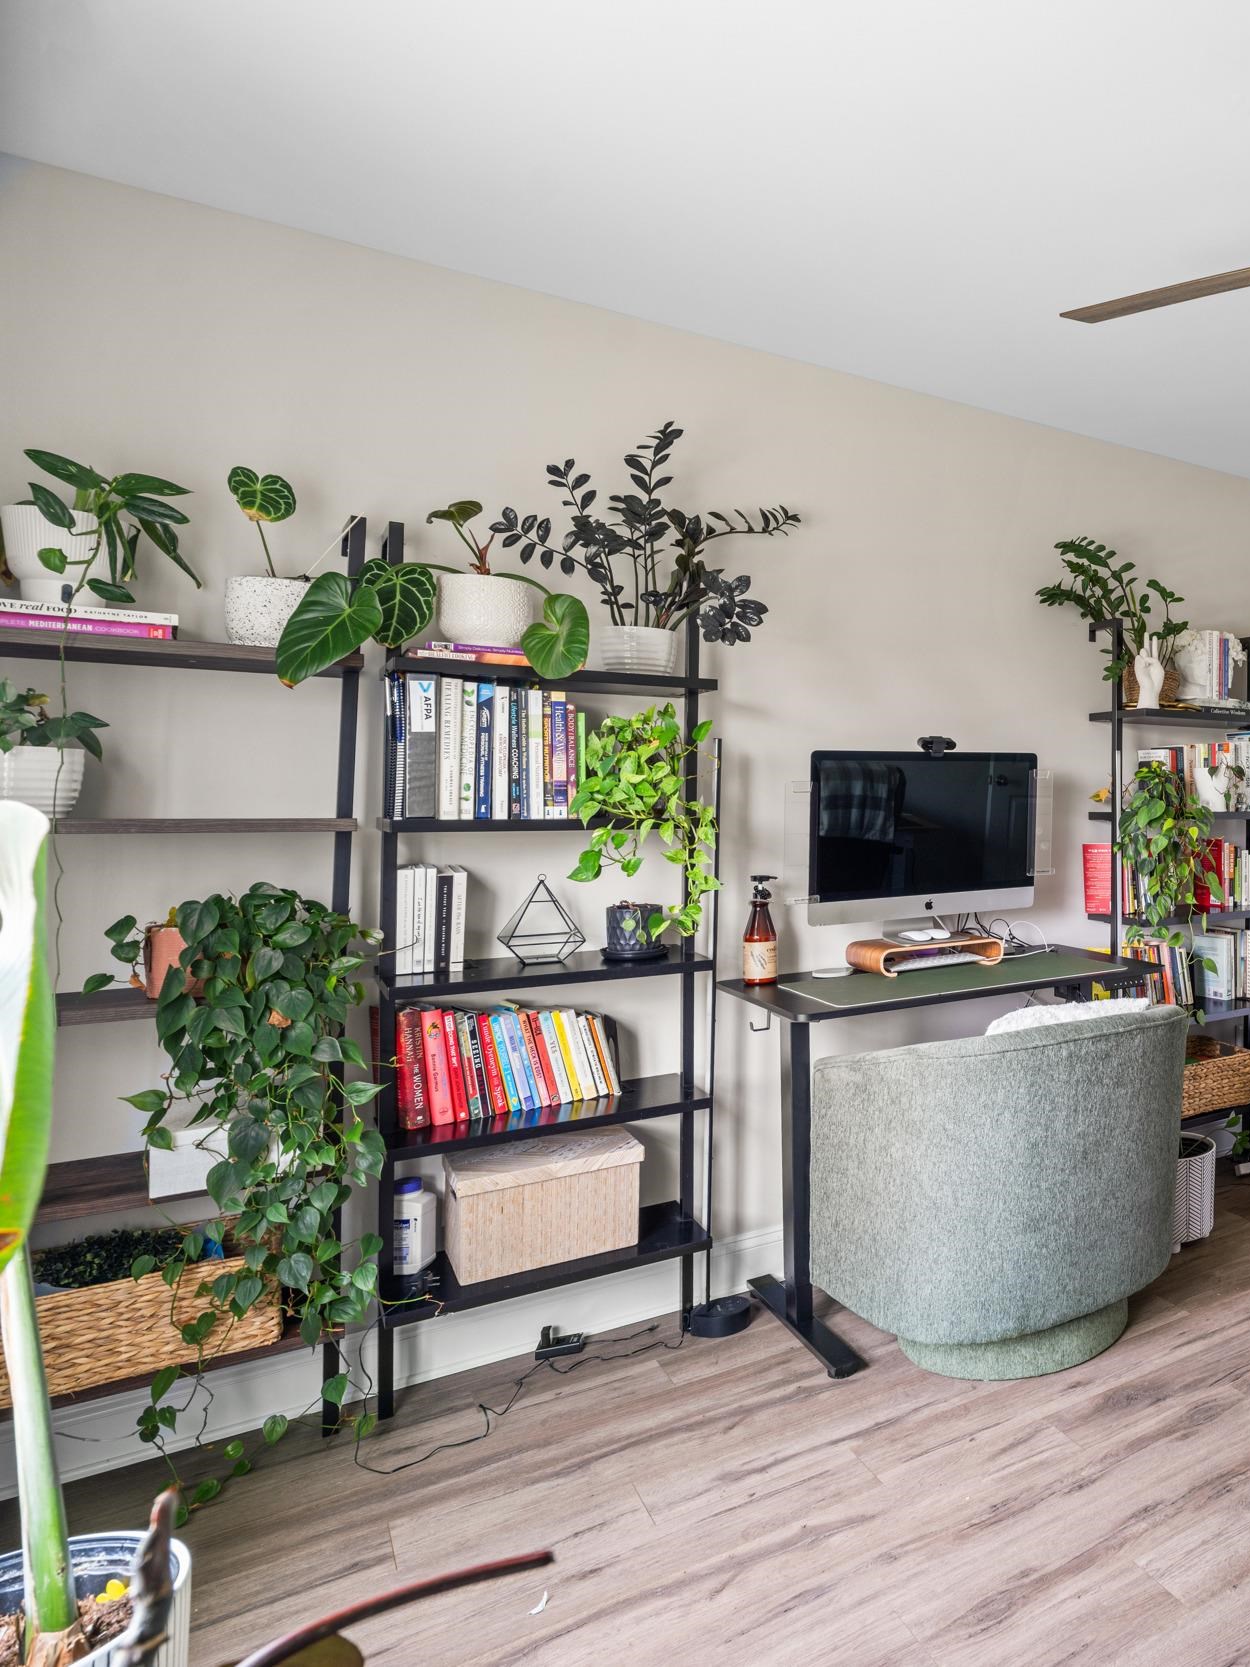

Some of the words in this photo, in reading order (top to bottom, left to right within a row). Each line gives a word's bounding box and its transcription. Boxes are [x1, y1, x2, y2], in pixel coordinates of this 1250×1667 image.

[424, 696, 432, 720] AFPA
[444, 682, 452, 716] HEALING
[555, 706, 564, 732] Health
[444, 720, 452, 760] REMEDIES
[555, 743, 565, 777] Wellness
[404, 1027, 414, 1062] HANNAH
[414, 1027, 423, 1059] KRISTIN
[482, 1022, 491, 1043] Tunde
[472, 1039, 481, 1068] SEEING
[413, 1074, 424, 1109] WOMEN
[493, 1087, 504, 1108] Speak
